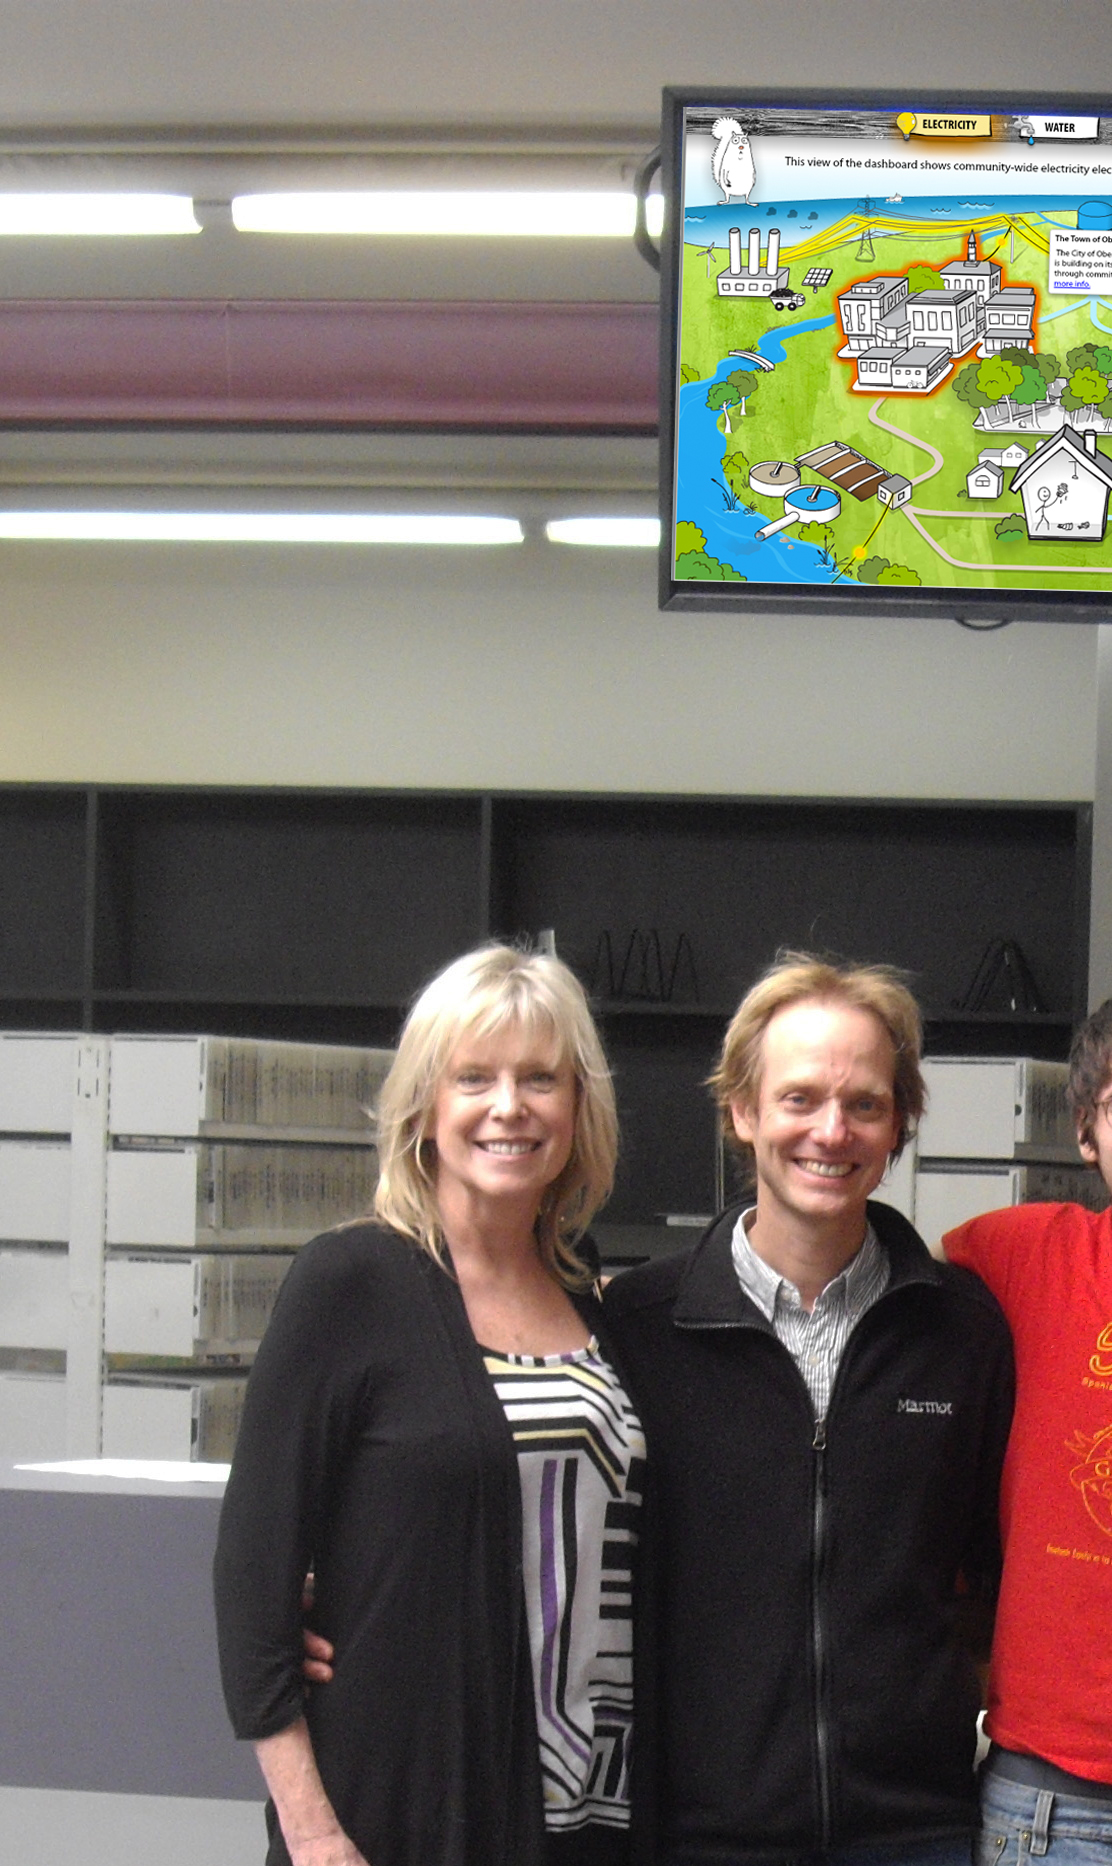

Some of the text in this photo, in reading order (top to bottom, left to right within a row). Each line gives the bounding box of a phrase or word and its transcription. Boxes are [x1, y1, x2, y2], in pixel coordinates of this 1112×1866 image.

[922, 120, 977, 130] ELECTRICITY
[1045, 122, 1075, 132] WATER
[785, 156, 805, 166] This
[807, 157, 830, 167] view
[833, 158, 844, 167] of
[846, 158, 862, 168] the
[864, 158, 918, 170] dashboard
[920, 160, 951, 170] shows
[953, 162, 1038, 174] community-wide
[1040, 164, 1090, 176] electricity
[1071, 249, 1086, 258] City
[1061, 260, 1092, 269] building
[1054, 270, 1084, 279] through
[1075, 280, 1090, 289] info.
